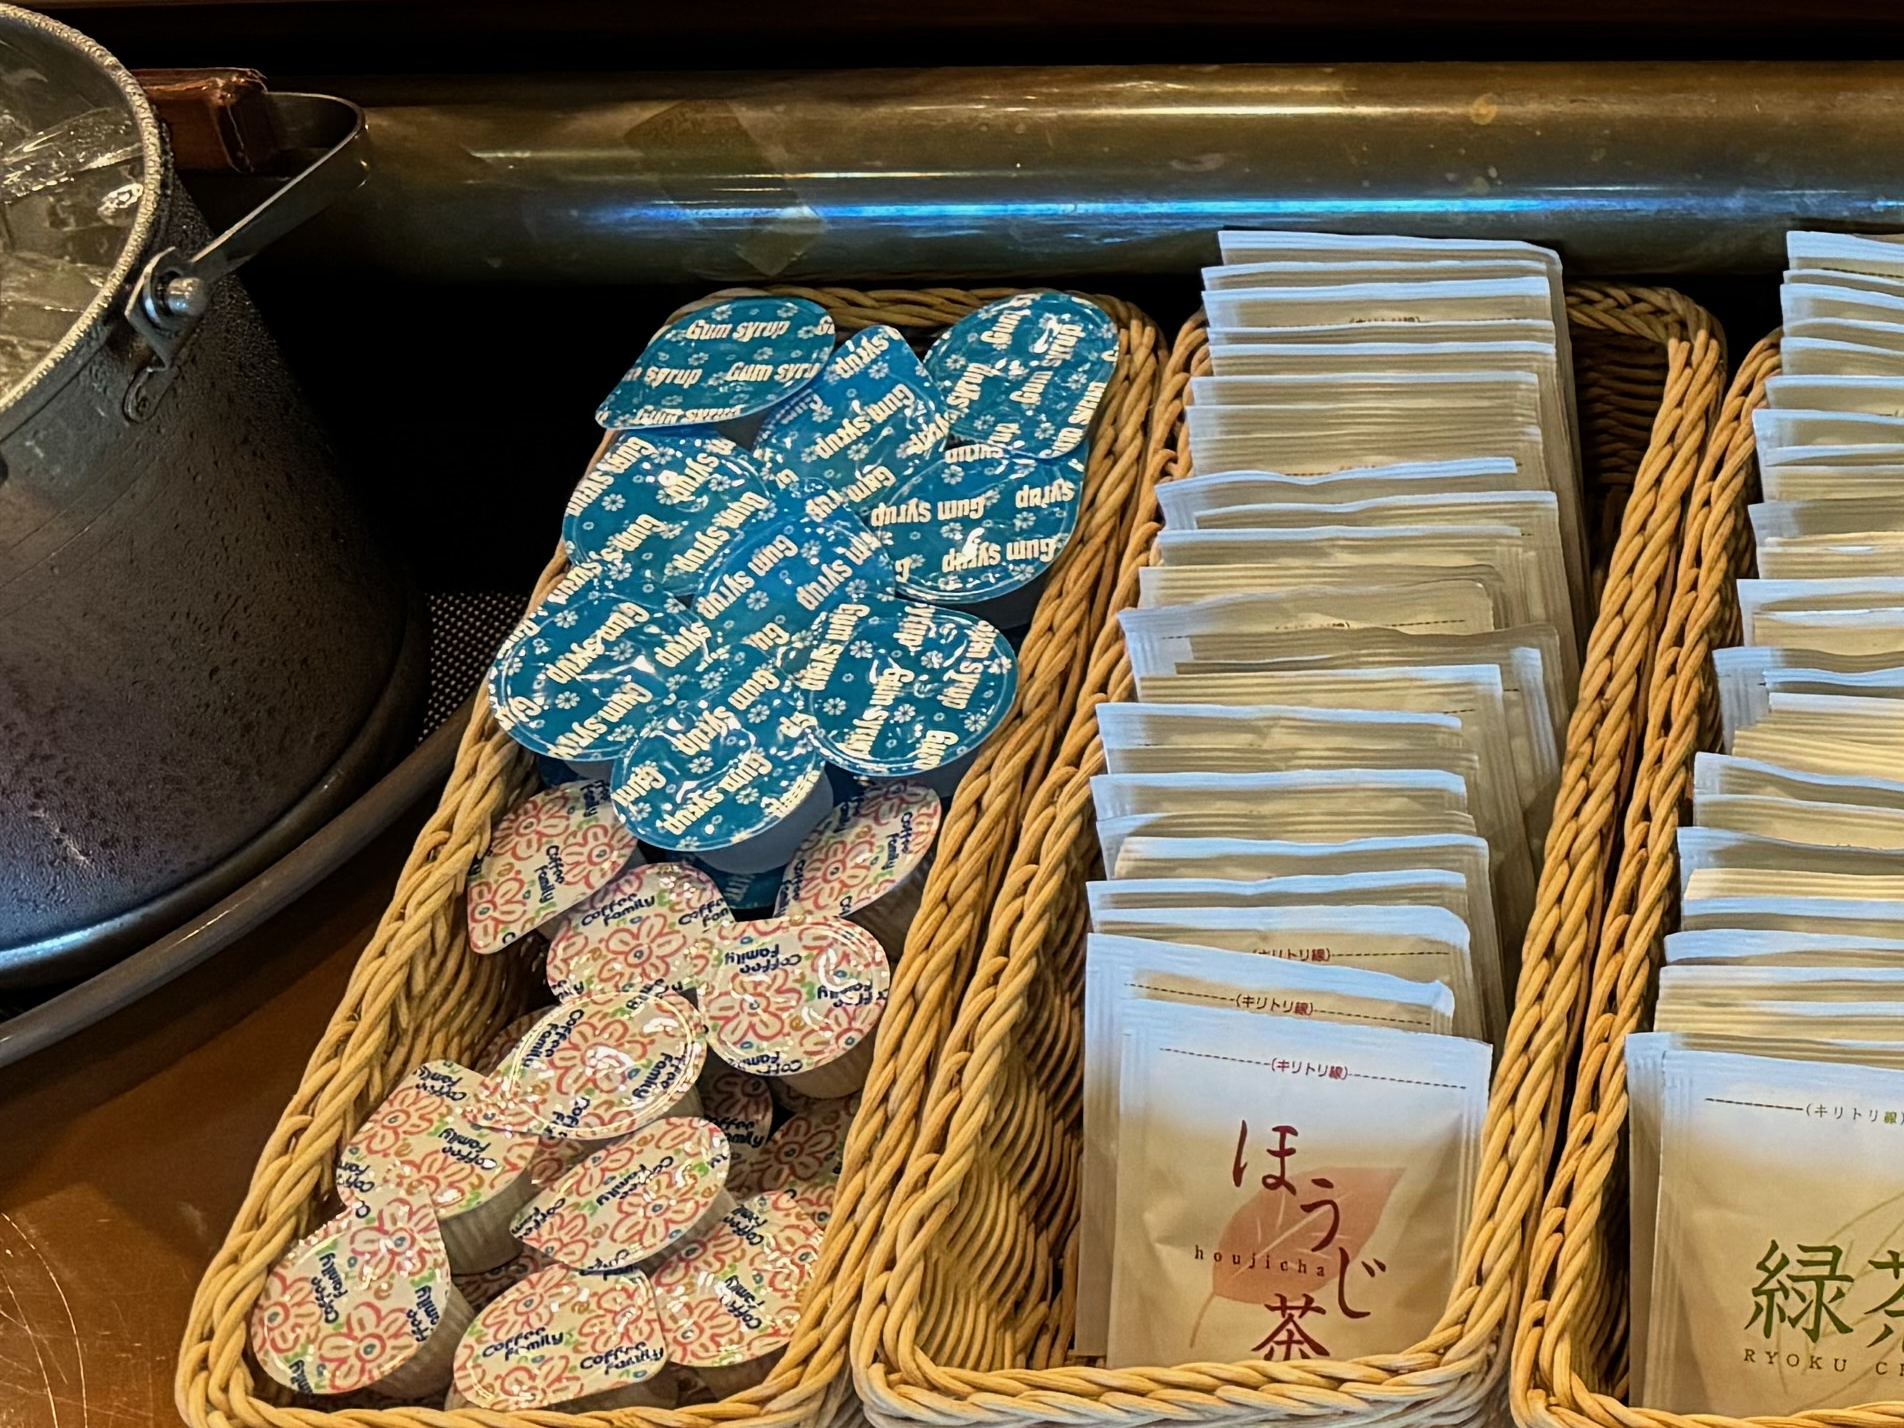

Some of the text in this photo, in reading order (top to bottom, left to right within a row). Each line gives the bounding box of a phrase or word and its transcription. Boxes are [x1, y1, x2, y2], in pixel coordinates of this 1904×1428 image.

[686, 320, 791, 342] Gum syrup
[725, 361, 774, 382] Gum
[834, 333, 889, 378] syrup
[644, 367, 703, 388] syrup
[814, 383, 915, 460] Gum syrup
[610, 436, 658, 473] Gum
[846, 465, 897, 502] Gum
[1015, 478, 1074, 508] syrup
[870, 495, 985, 527] Gum syrup
[669, 491, 770, 573] Gum syrup
[1006, 537, 1058, 563] Gum
[697, 534, 798, 620] Gum syrup
[797, 559, 853, 611] syrup
[825, 603, 870, 643] Gum
[546, 601, 650, 684] Gum syrup
[654, 622, 711, 668] syrup
[598, 681, 653, 723] Gum
[676, 668, 780, 756] Gum syrup
[662, 751, 773, 836] Gum syrup
[545, 844, 565, 885] Coffee
[534, 866, 556, 904] Family
[581, 893, 639, 927] Coffee
[602, 894, 656, 927] Family
[725, 944, 780, 966] Family
[740, 953, 802, 974] Coffee
[1235, 993, 1313, 1016] (キリトリ線)
[544, 1008, 585, 1059] Coffee
[632, 1051, 675, 1101] Family
[1271, 1057, 1348, 1080] (キリトリ線)
[438, 1127, 492, 1155] Family
[441, 1145, 498, 1171] Coffee
[1231, 1119, 1387, 1361] ほうじ茶
[318, 1252, 347, 1298] Family
[1194, 1244, 1325, 1277] houjicha
[311, 1276, 339, 1323] Coffee
[482, 1326, 546, 1358] Coffee
[505, 1330, 564, 1361] Family
[580, 1341, 647, 1369] Coffee
[1743, 1347, 1848, 1373] RYOKU
